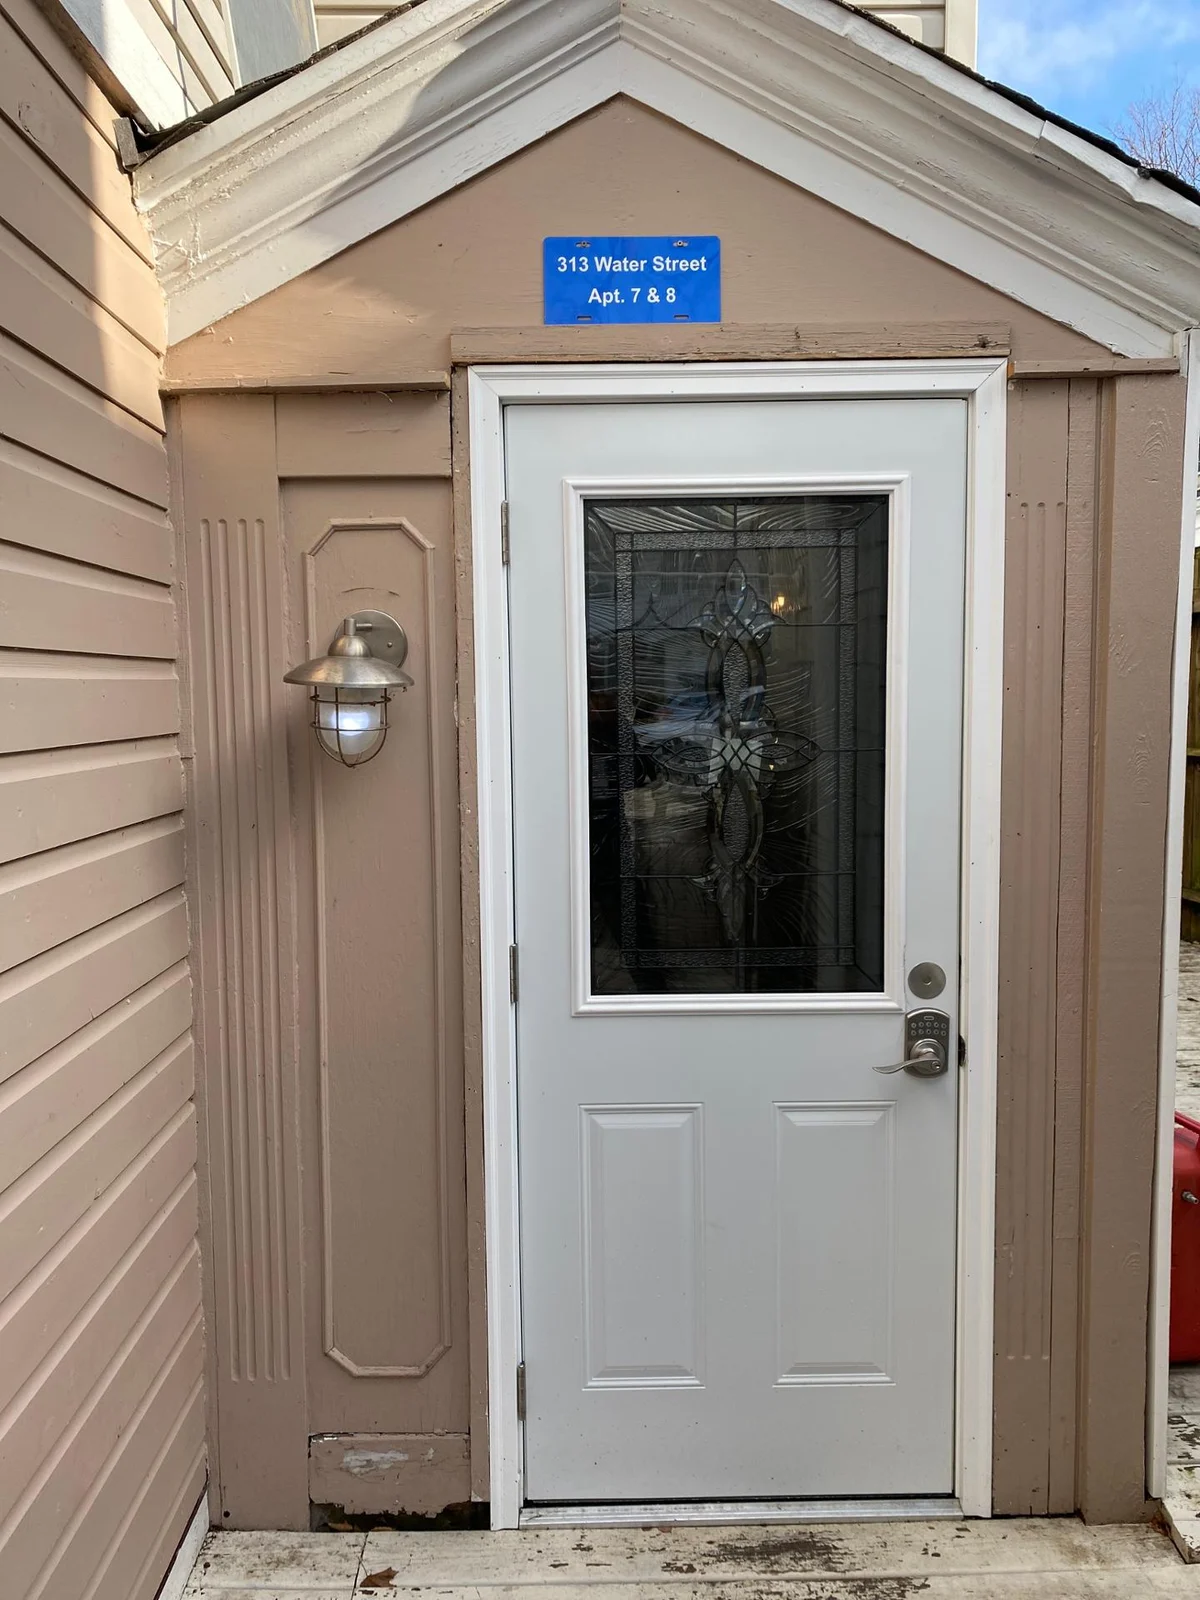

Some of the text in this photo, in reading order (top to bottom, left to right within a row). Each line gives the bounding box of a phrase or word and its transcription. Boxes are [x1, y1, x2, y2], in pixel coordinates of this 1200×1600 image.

[557, 255, 707, 272] 313 Water Street
[588, 287, 677, 307] Apt. 7 & 8
